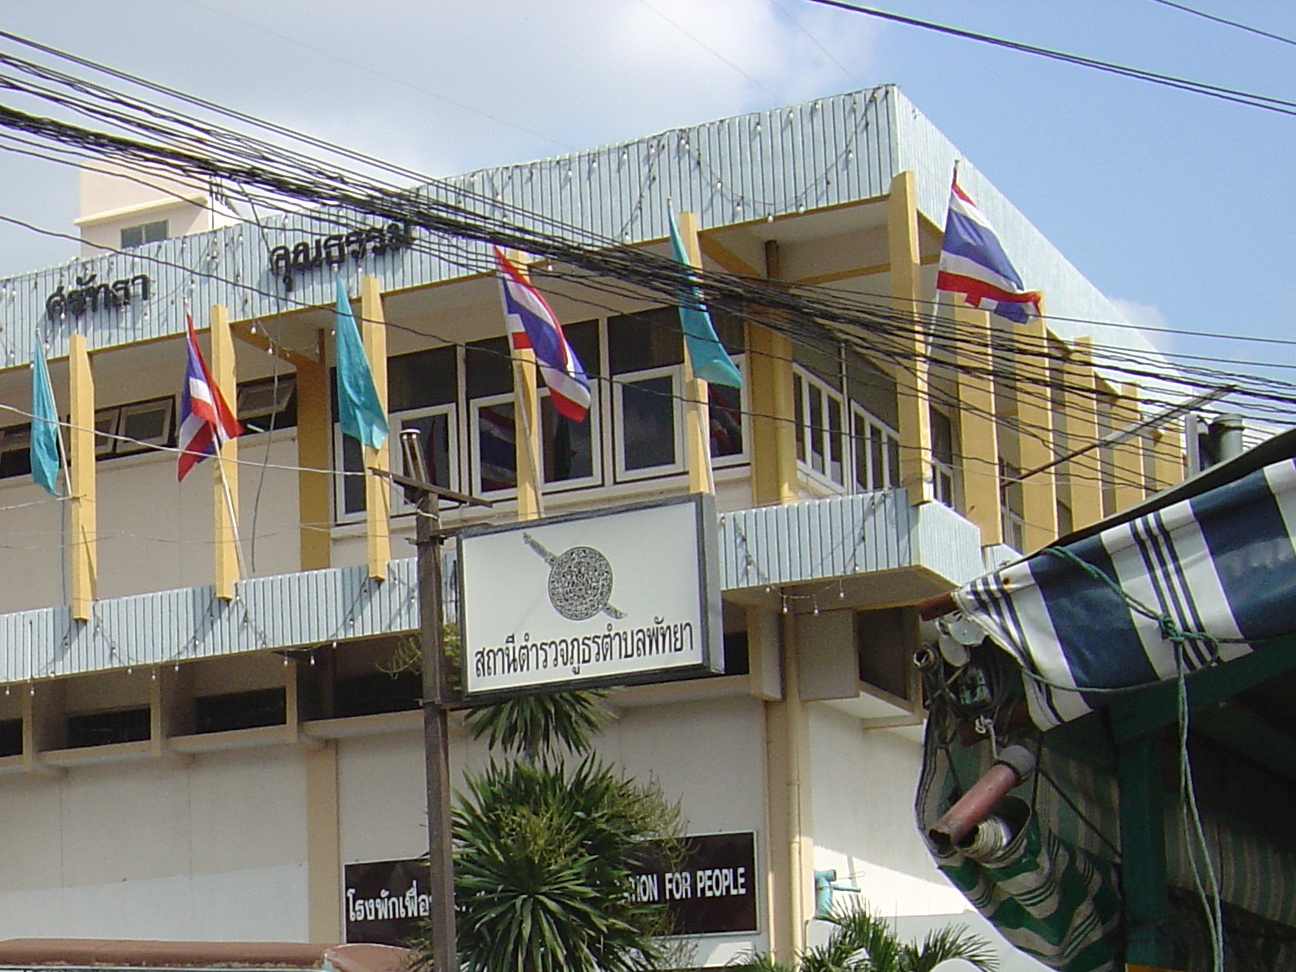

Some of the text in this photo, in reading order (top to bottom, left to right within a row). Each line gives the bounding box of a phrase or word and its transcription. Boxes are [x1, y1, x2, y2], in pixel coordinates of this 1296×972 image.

[475, 616, 693, 677] สถานีตำรวจภูธรตำบลพัทยา
[665, 872, 692, 901] FOR
[697, 866, 747, 898] PEOPLE
